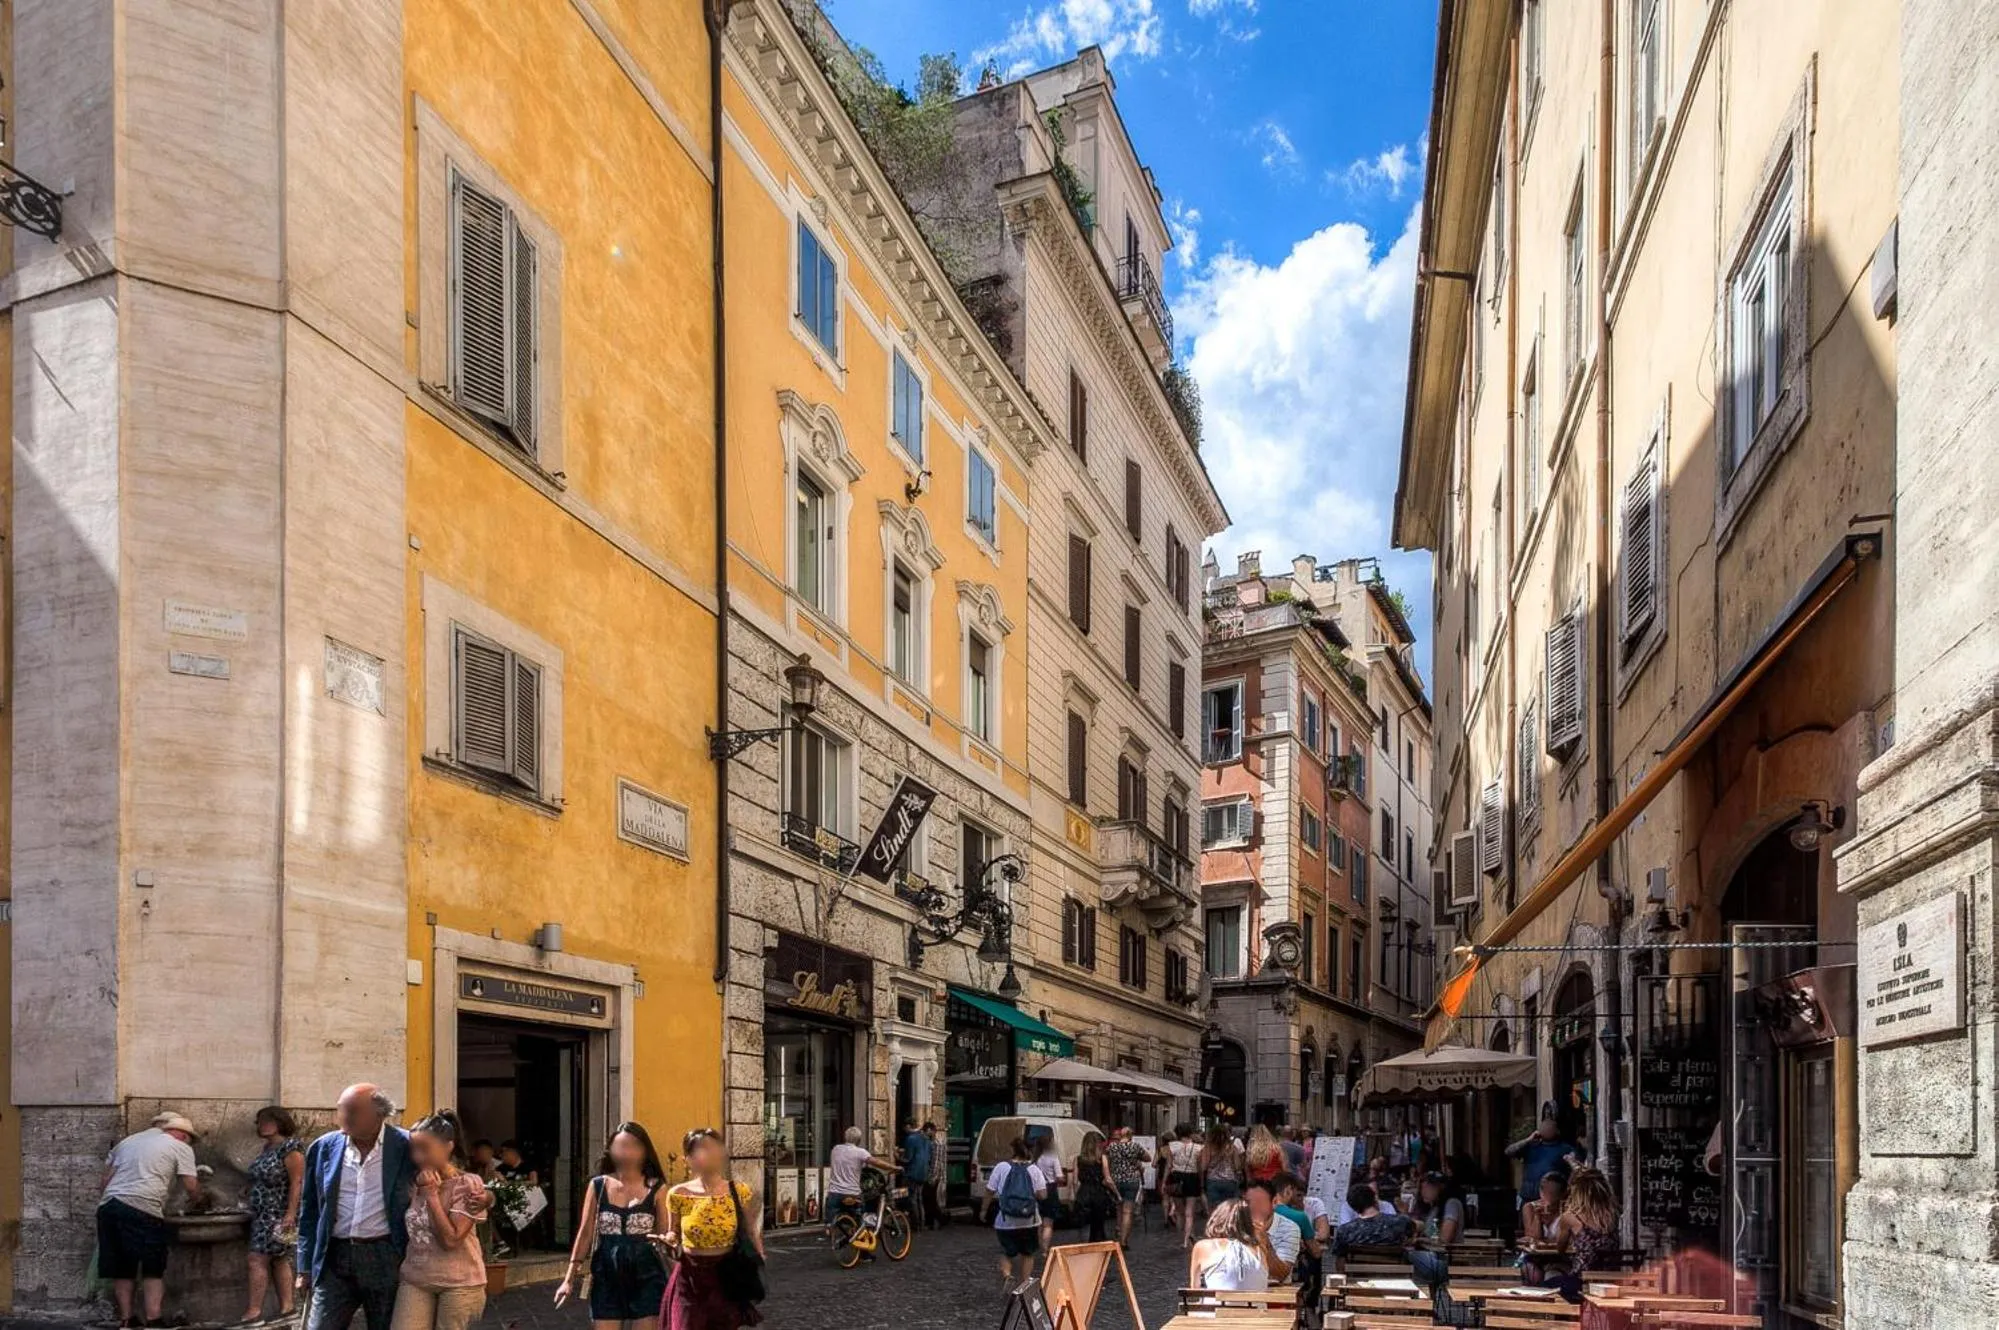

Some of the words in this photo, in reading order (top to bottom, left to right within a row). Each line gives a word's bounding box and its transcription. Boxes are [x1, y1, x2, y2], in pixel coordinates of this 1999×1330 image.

[647, 800, 663, 816] VIA
[624, 819, 684, 849] MADDALENA
[873, 810, 914, 873] Lindt
[503, 981, 516, 994] LA
[518, 983, 575, 1002] MADDALENA
[786, 971, 844, 1016] Lindt
